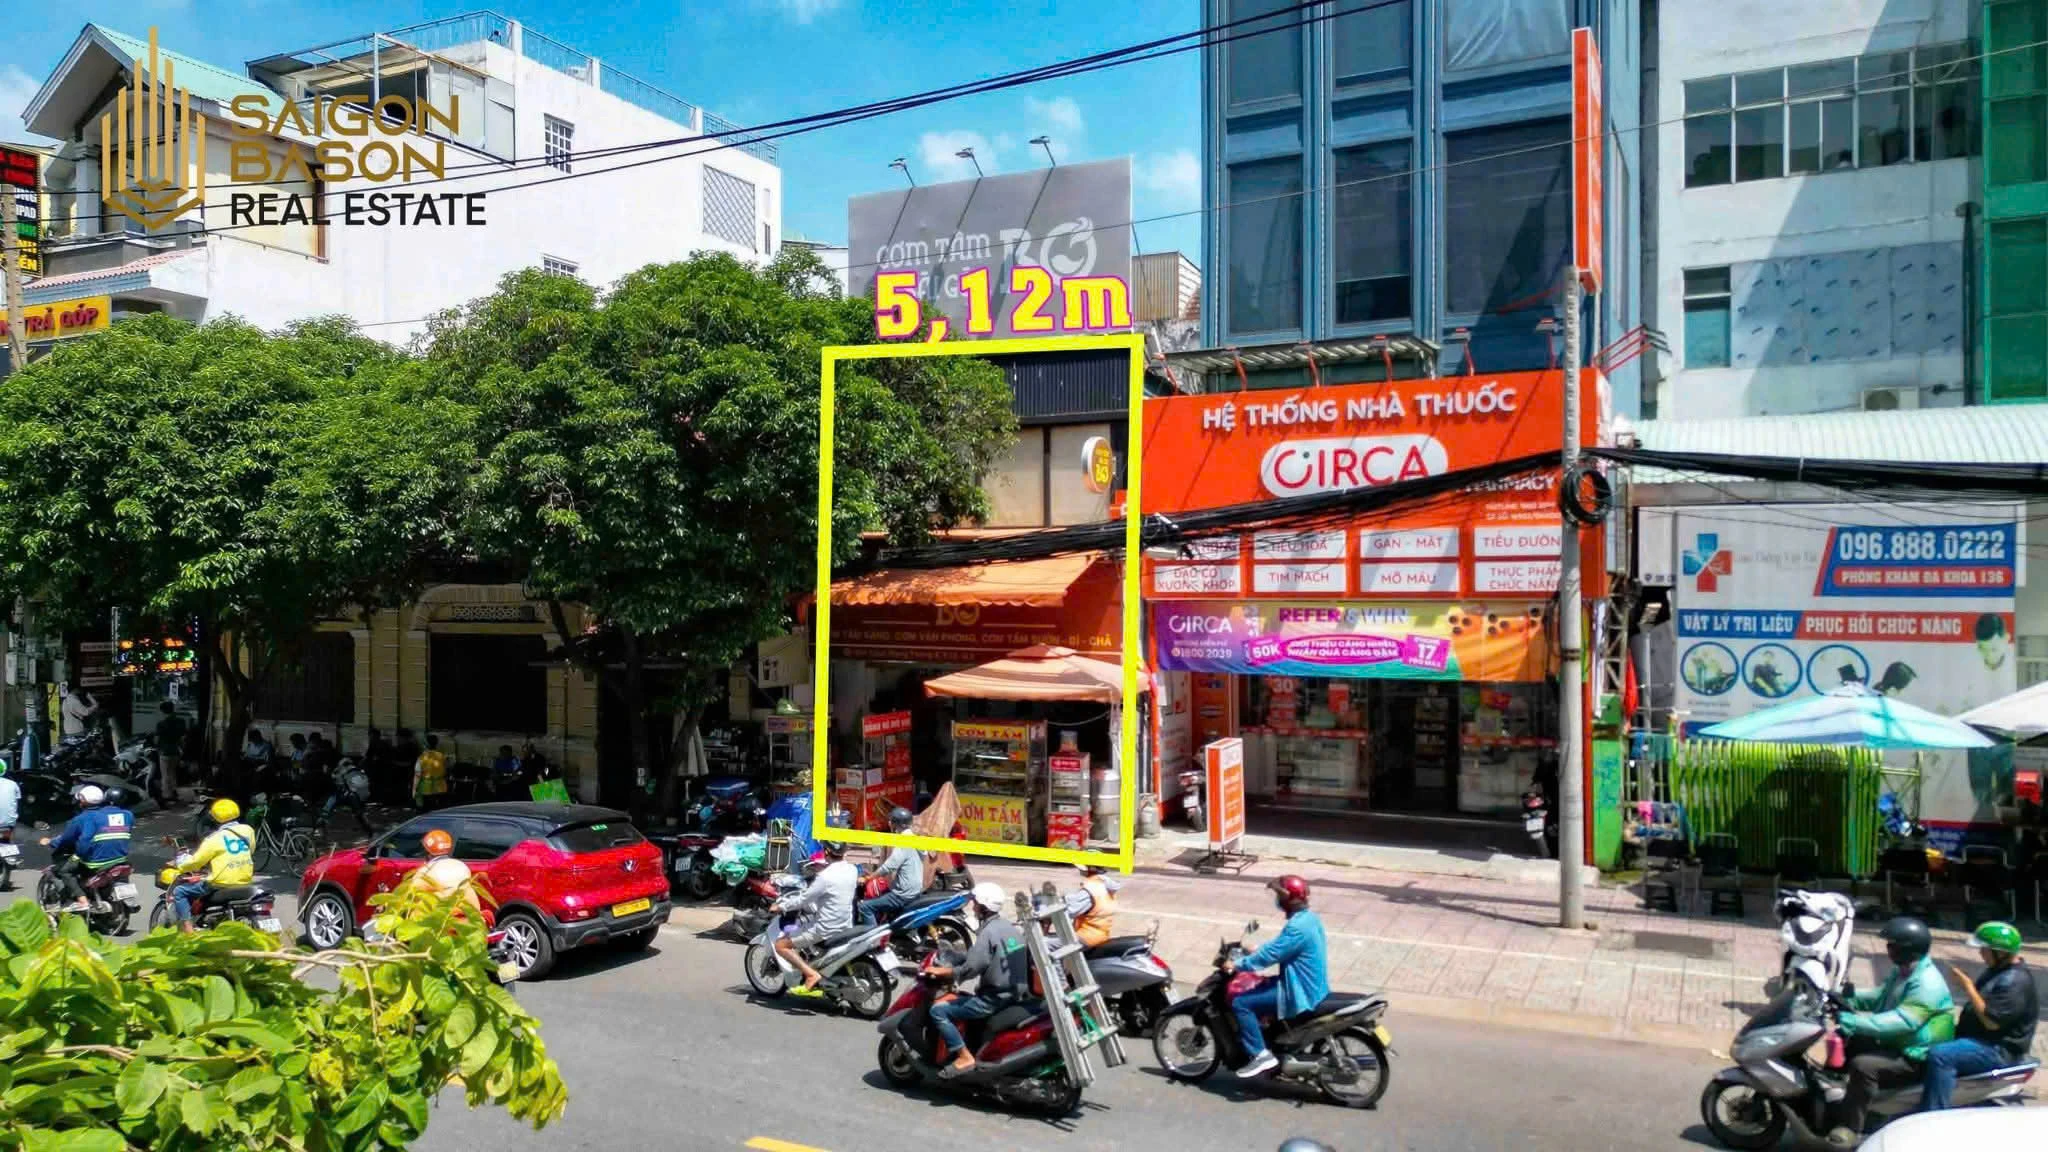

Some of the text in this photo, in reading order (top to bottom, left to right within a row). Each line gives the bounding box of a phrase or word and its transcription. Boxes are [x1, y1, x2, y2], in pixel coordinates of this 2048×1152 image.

[1202, 381, 1517, 432] HỆ THỐNG NHÀ THUỐC
[1273, 445, 1430, 489] CIRCA
[1518, 533, 1561, 548] ĐƯỜN
[1839, 530, 2006, 561] 096.888.0222
[1270, 572, 1290, 583] TIM
[1168, 615, 1233, 634] CIRCA
[1279, 607, 1342, 623] REFER
[1361, 607, 1409, 624] WIN
[1713, 612, 1730, 631] LÝ
[1733, 615, 1757, 635] TRỊ
[1761, 613, 1793, 635] LIỆU
[1805, 615, 1844, 636] PHỤC
[1417, 643, 1438, 660] 17
